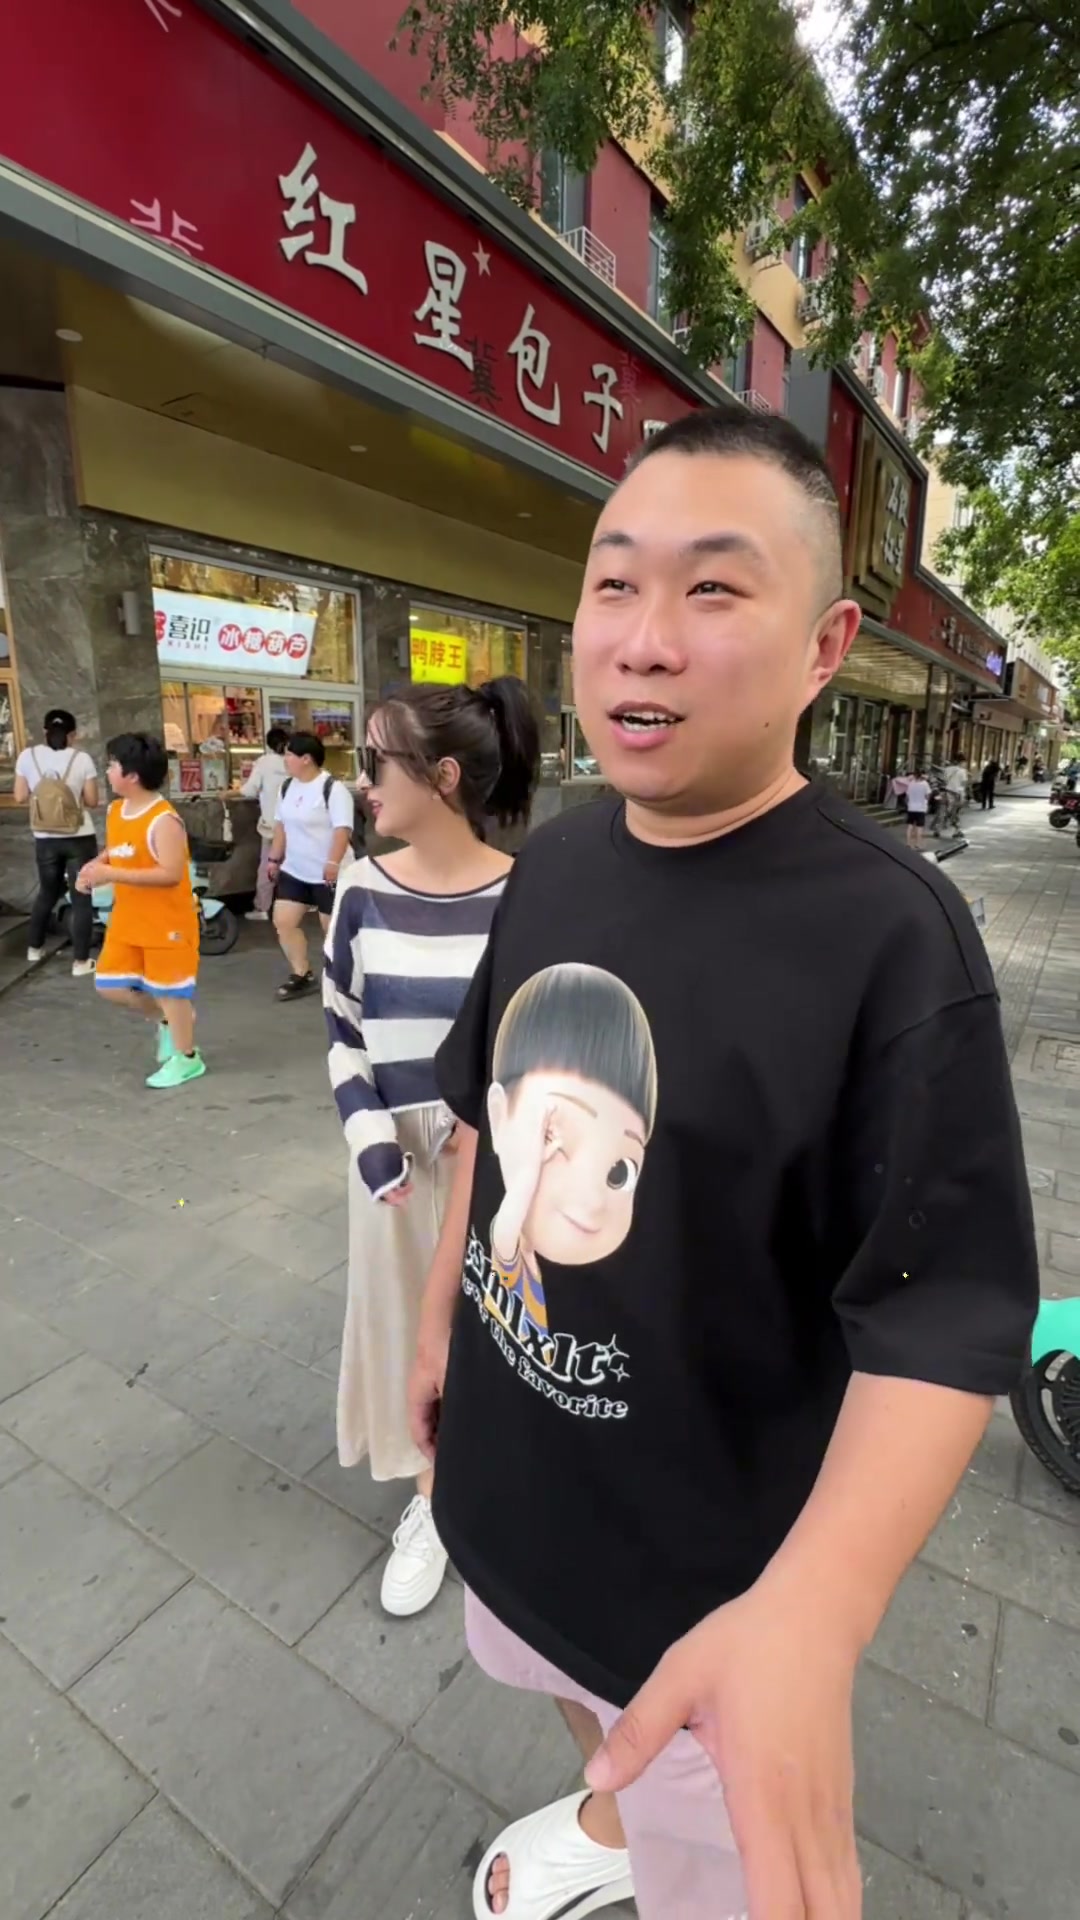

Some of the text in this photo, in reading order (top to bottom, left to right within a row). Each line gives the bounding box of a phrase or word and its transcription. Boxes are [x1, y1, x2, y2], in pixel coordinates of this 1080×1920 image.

[279, 143, 668, 453] 红星包子
[168, 614, 212, 642] 喜识
[219, 625, 306, 657] 冰糖葫芦
[411, 637, 463, 668] 鸭脖王
[490, 1317, 517, 1367] the
[517, 1355, 629, 1419] favorite
